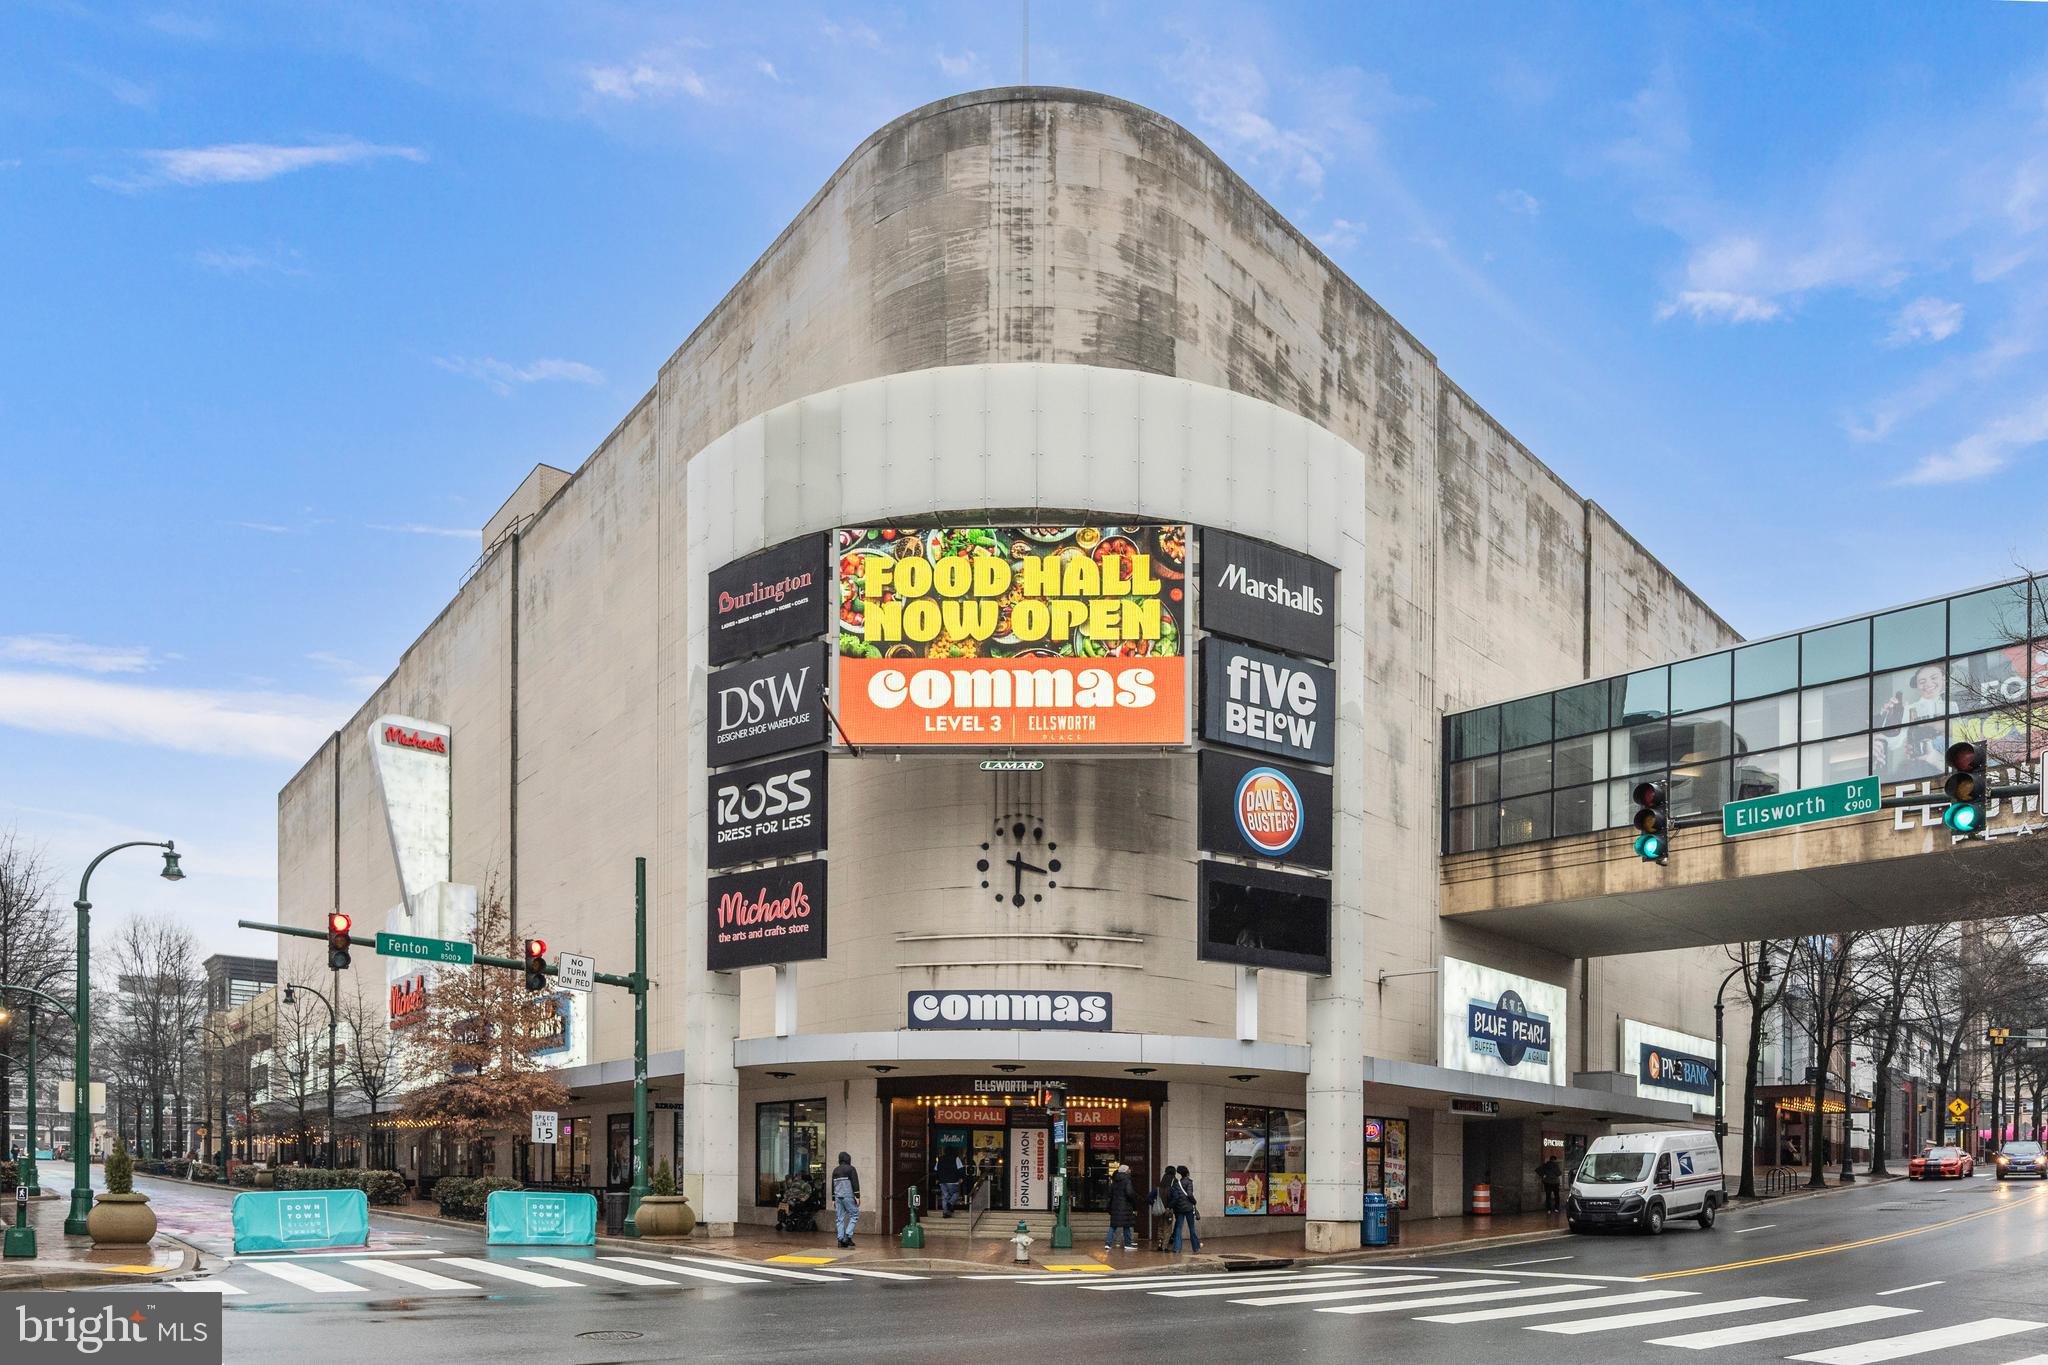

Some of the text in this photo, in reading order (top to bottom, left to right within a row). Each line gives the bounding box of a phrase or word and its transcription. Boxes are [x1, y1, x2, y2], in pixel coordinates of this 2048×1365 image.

[864, 554, 1161, 598] FOOD HALL
[718, 572, 812, 614] Burlington
[1217, 563, 1324, 616] Marshalls
[864, 598, 1161, 642] NOW OPEN
[868, 668, 1156, 709] commas
[1227, 655, 1317, 716] five
[718, 666, 811, 732] DSW
[717, 713, 810, 744] DESIGNER SHOE WAREHOUSE
[925, 715, 1002, 732] LEVEL 3
[1029, 715, 1096, 731] ELLSWORTH
[1226, 701, 1316, 750] BELOW
[385, 725, 446, 753] Michaels
[984, 761, 1038, 769] LAMAR
[717, 769, 812, 826] ROSS
[1246, 789, 1294, 812] DAVE &
[1736, 785, 1863, 827] Ellsworth Dr
[1852, 799, 1872, 811] 900
[717, 814, 811, 843] DRESS FOR LESS
[1247, 812, 1295, 832] BUSTER'S
[717, 882, 811, 929] Michaels
[718, 923, 809, 943] the arts and crafts store
[388, 939, 454, 955] Fenton St
[440, 953, 457, 961] 8500
[567, 967, 587, 977] TURN
[571, 958, 583, 967] NO
[561, 976, 590, 987] ON RED
[913, 994, 1107, 1023] commas
[1474, 1012, 1546, 1045] BLUE PEARL
[1474, 1040, 1496, 1054] BUFFET
[974, 1080, 1027, 1092] ELLSWORTH
[1683, 1063, 1709, 1086] BANK
[937, 1110, 1002, 1120] FOOD HALL
[1074, 1112, 1100, 1123] BAR
[538, 1128, 553, 1139] 15
[1021, 1131, 1029, 1207] NOW SERVING!
